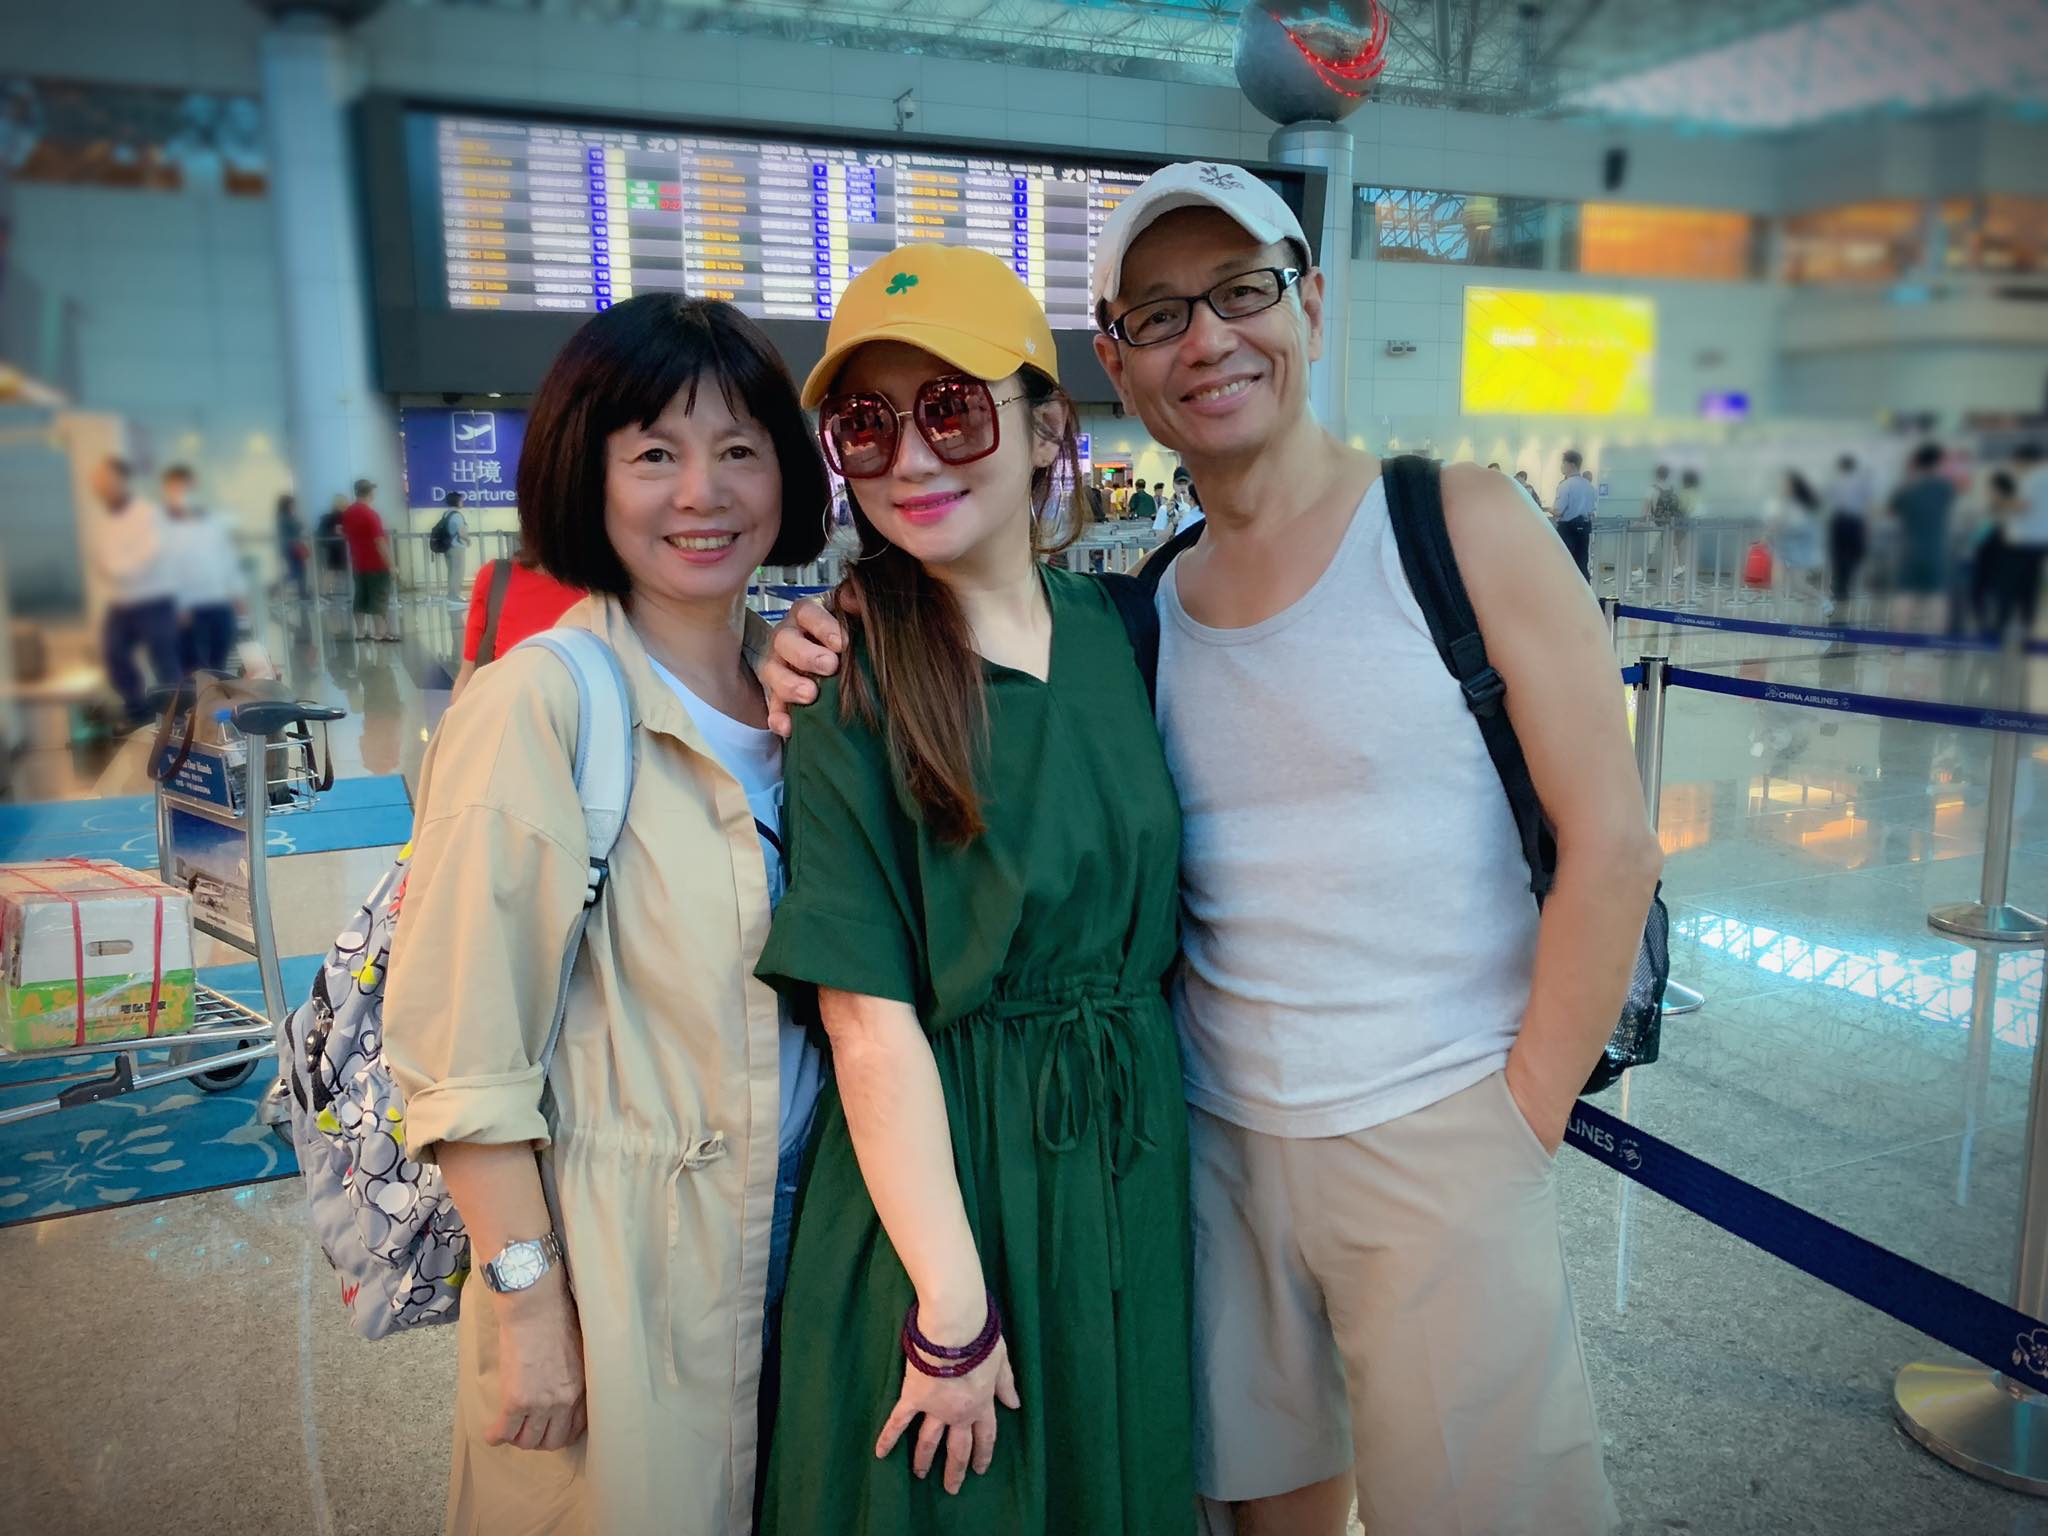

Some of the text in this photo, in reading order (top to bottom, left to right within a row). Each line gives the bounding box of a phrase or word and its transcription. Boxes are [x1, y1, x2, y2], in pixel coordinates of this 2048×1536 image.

[452, 459, 503, 484] 出境
[432, 486, 517, 502] Darture
[1779, 691, 1839, 706] CHINA AIRLINES
